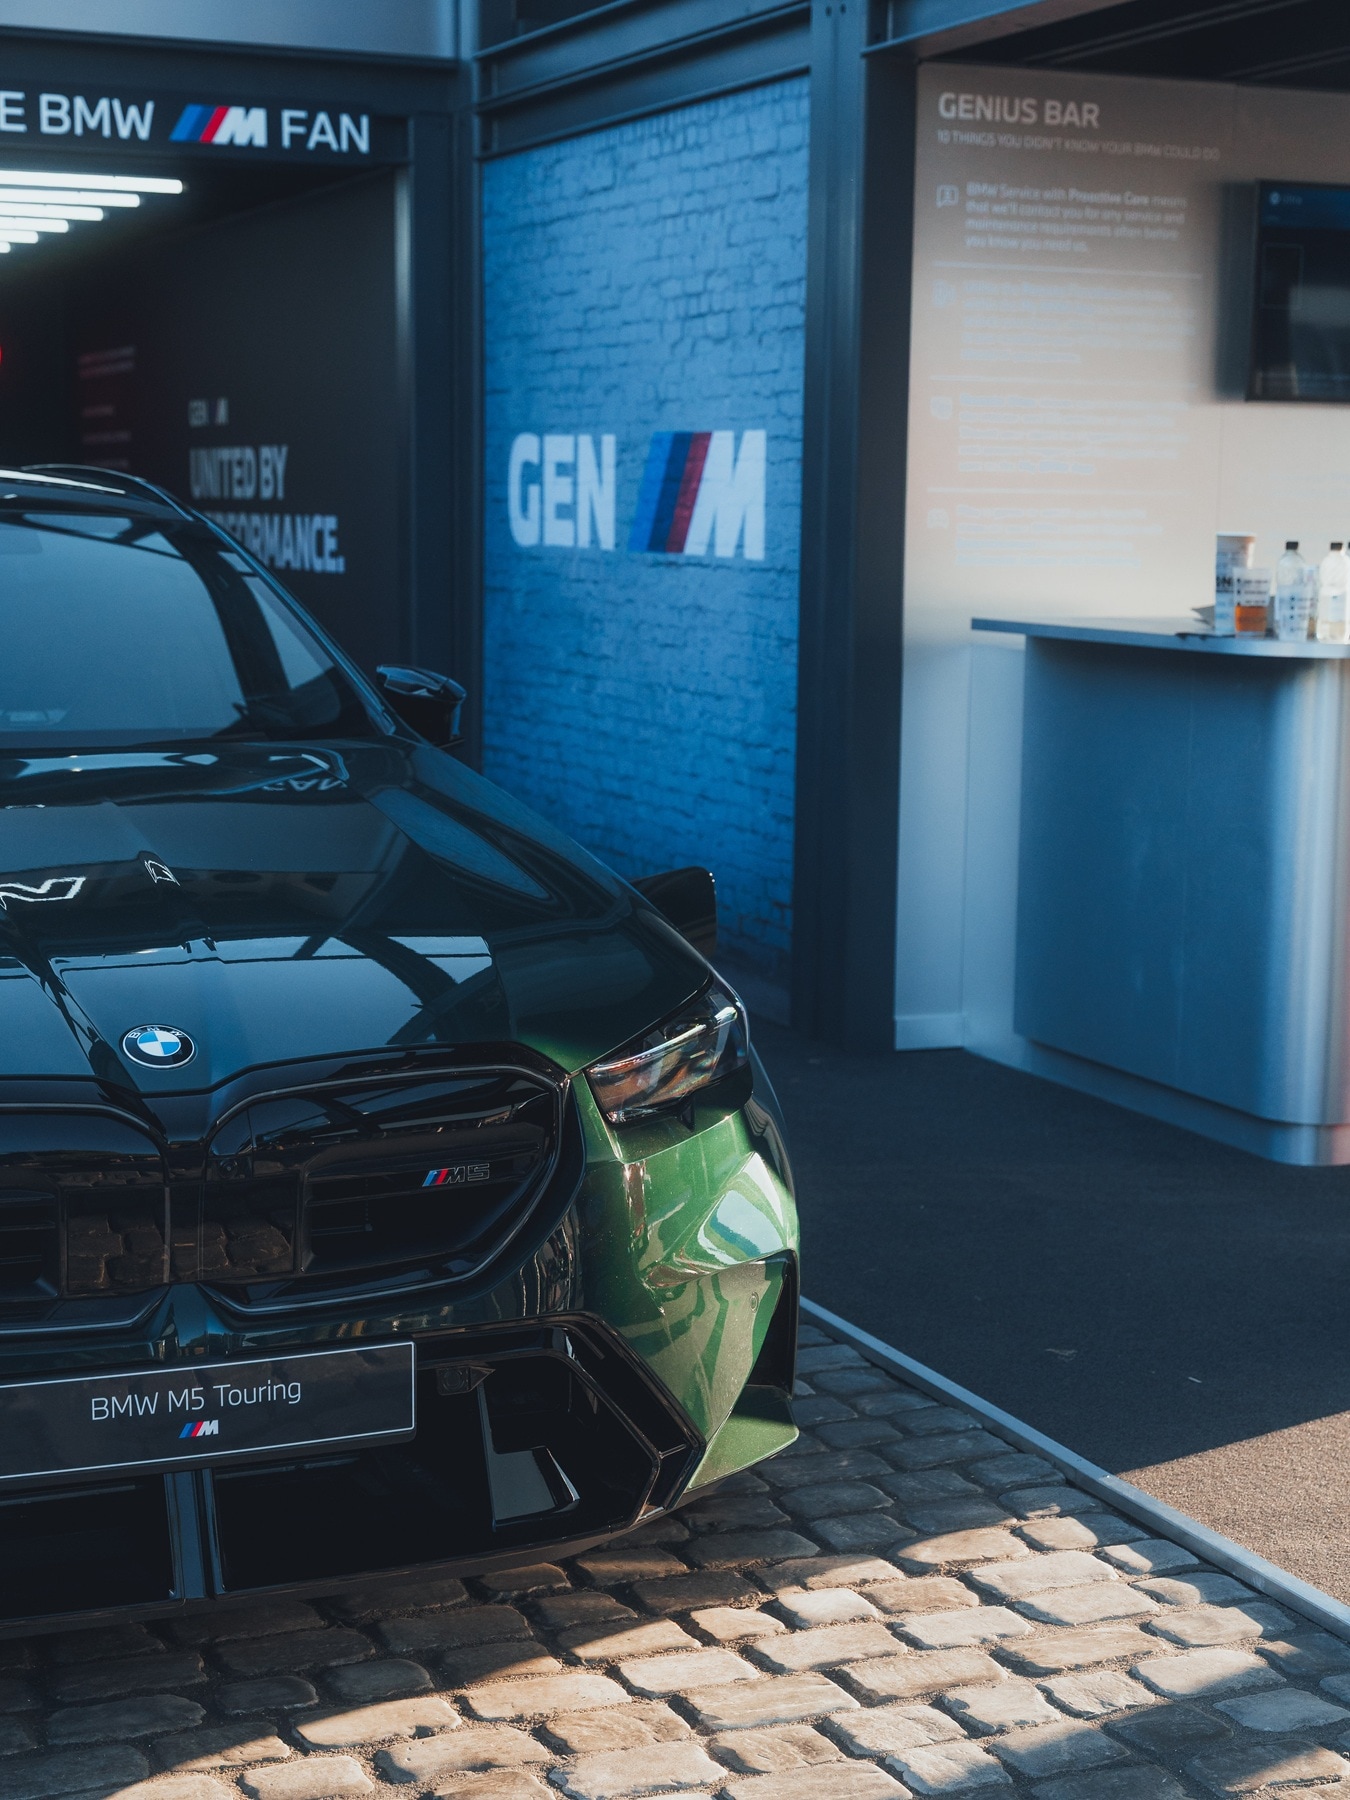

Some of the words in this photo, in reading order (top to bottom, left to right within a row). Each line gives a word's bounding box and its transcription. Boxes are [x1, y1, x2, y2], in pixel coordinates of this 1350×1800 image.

[39, 93, 155, 140] BMW
[280, 109, 370, 153] FAN
[938, 92, 1038, 124] GENIUS
[1044, 100, 1100, 128] BAR
[189, 446, 258, 499] UNITED
[259, 444, 288, 499] BY
[507, 432, 616, 550] GEN
[682, 429, 767, 560] M
[443, 1163, 490, 1184] M5
[91, 1391, 159, 1421] BMW
[168, 1387, 205, 1413] M5
[213, 1379, 301, 1407] Touring
